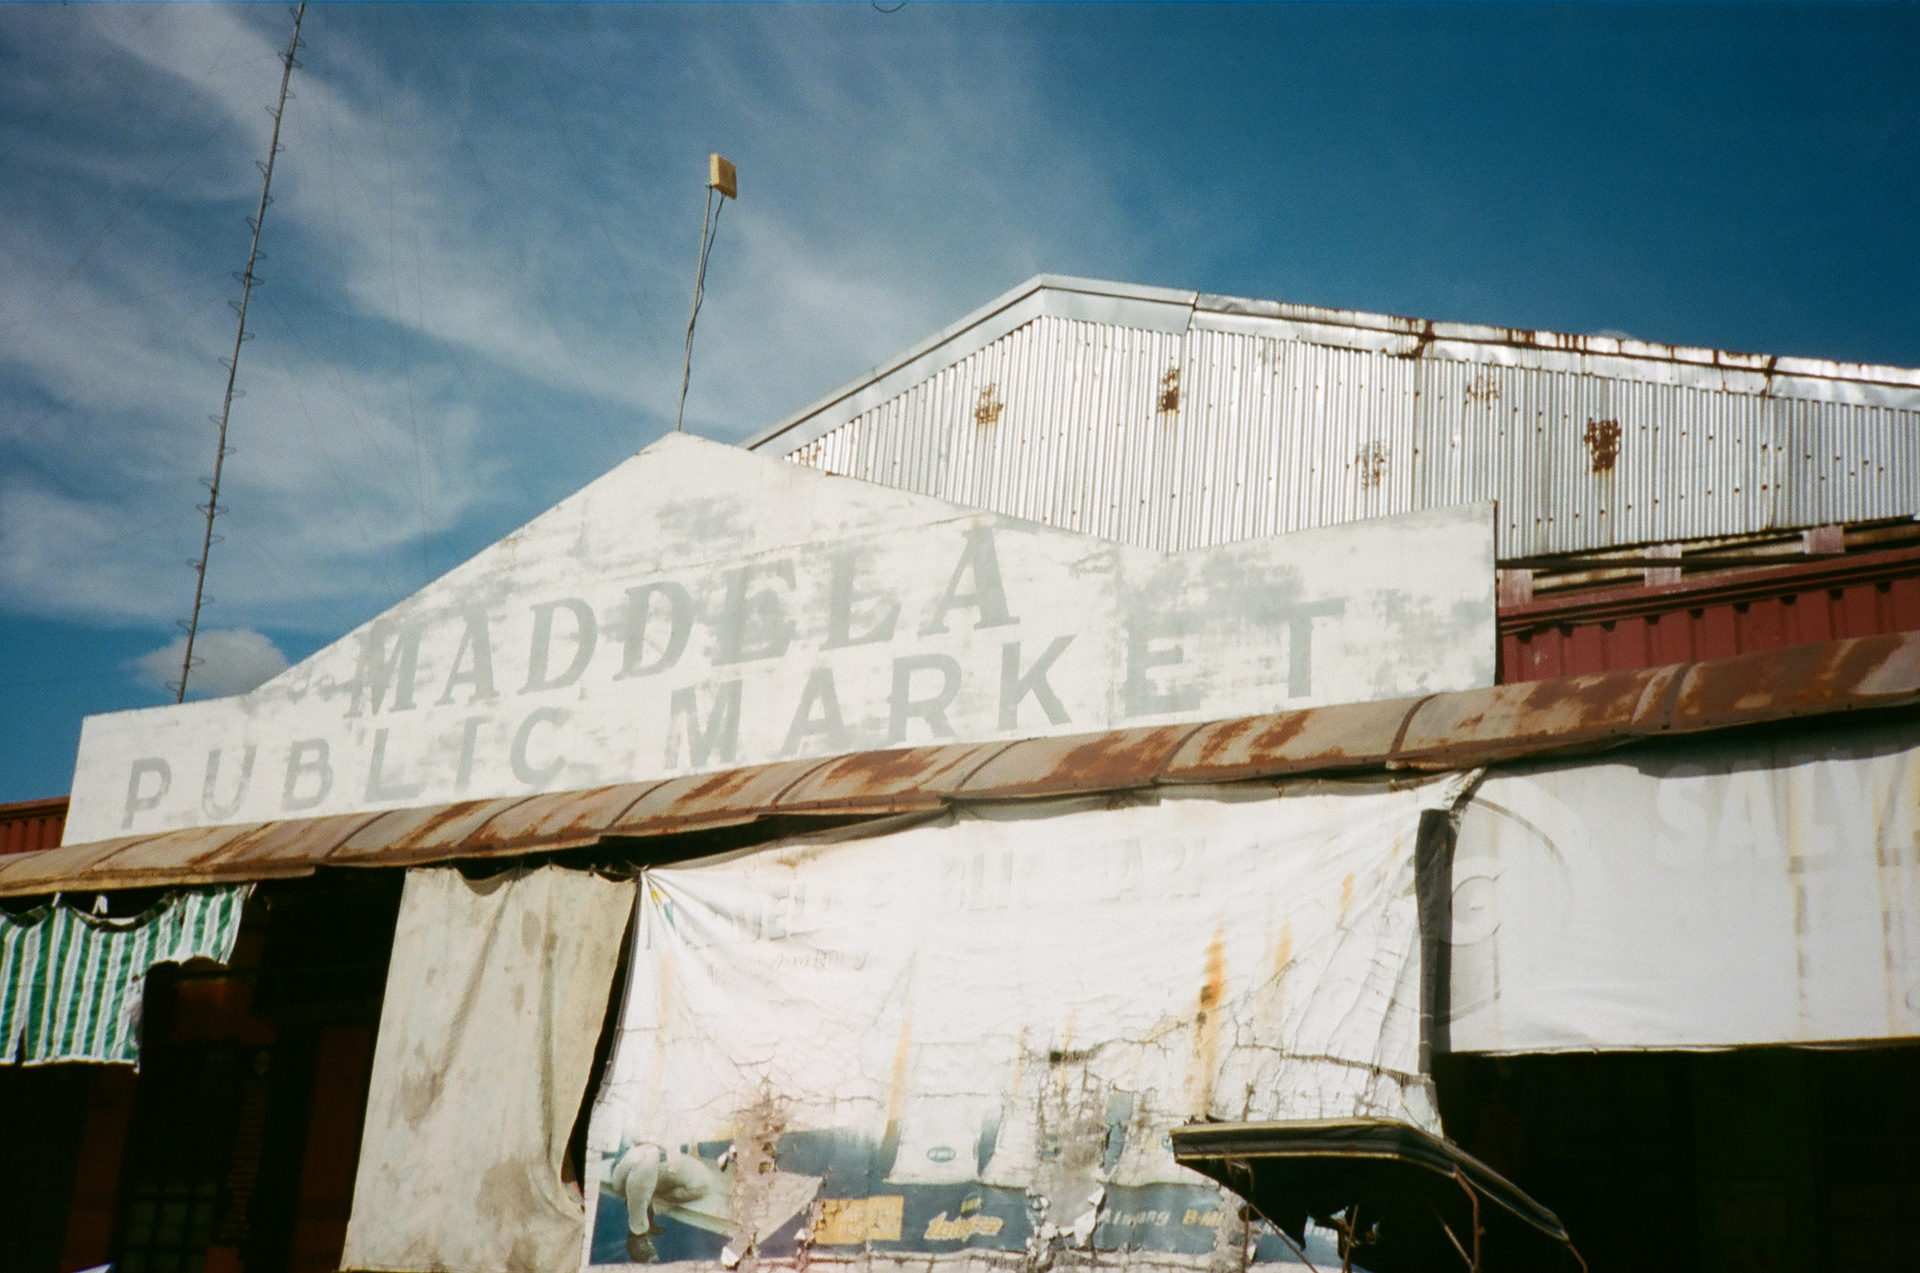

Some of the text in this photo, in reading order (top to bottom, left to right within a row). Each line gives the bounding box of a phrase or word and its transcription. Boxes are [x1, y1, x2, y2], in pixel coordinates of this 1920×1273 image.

[121, 599, 1345, 830] PUBLIC MARKET
[344, 523, 1021, 719] MADDELA
